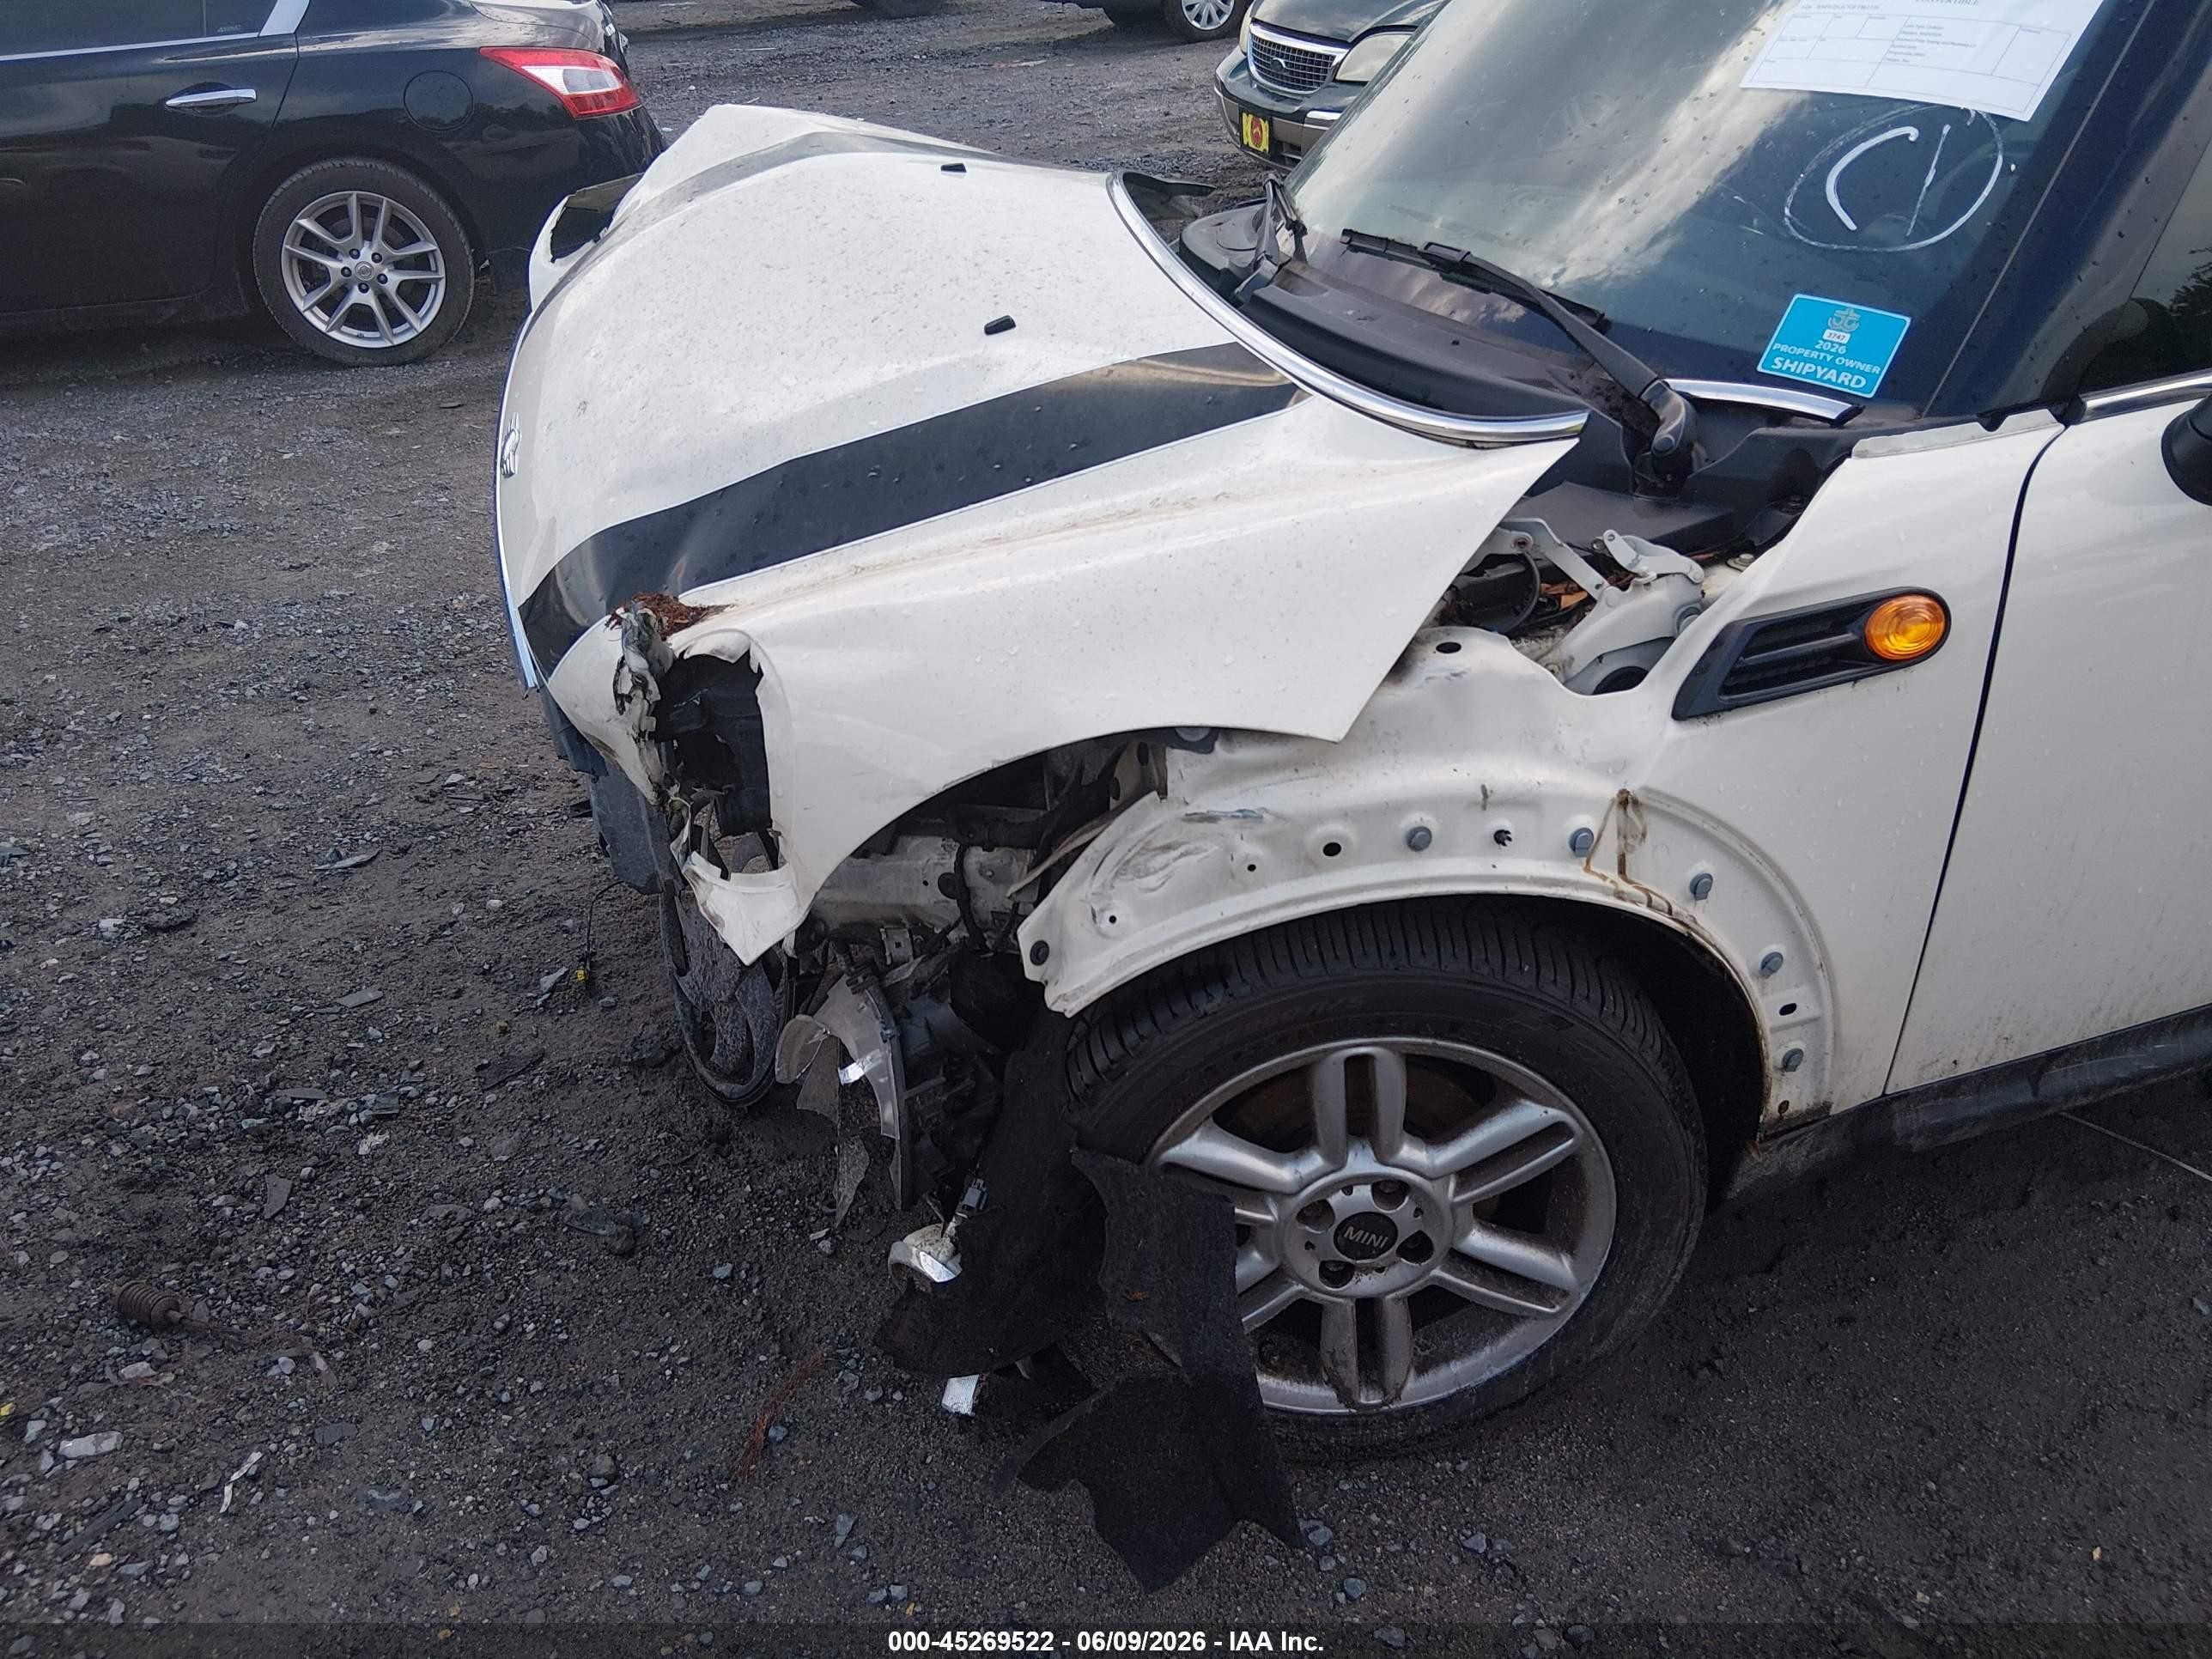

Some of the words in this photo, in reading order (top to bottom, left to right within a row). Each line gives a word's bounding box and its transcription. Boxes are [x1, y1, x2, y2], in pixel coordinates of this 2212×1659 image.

[1772, 343, 1834, 362] PROPERTY
[1834, 356, 1881, 374] OWNER
[1814, 340, 1847, 355] 2026
[1771, 356, 1867, 389] SHIPYARD
[1343, 1225, 1389, 1249] MINI
